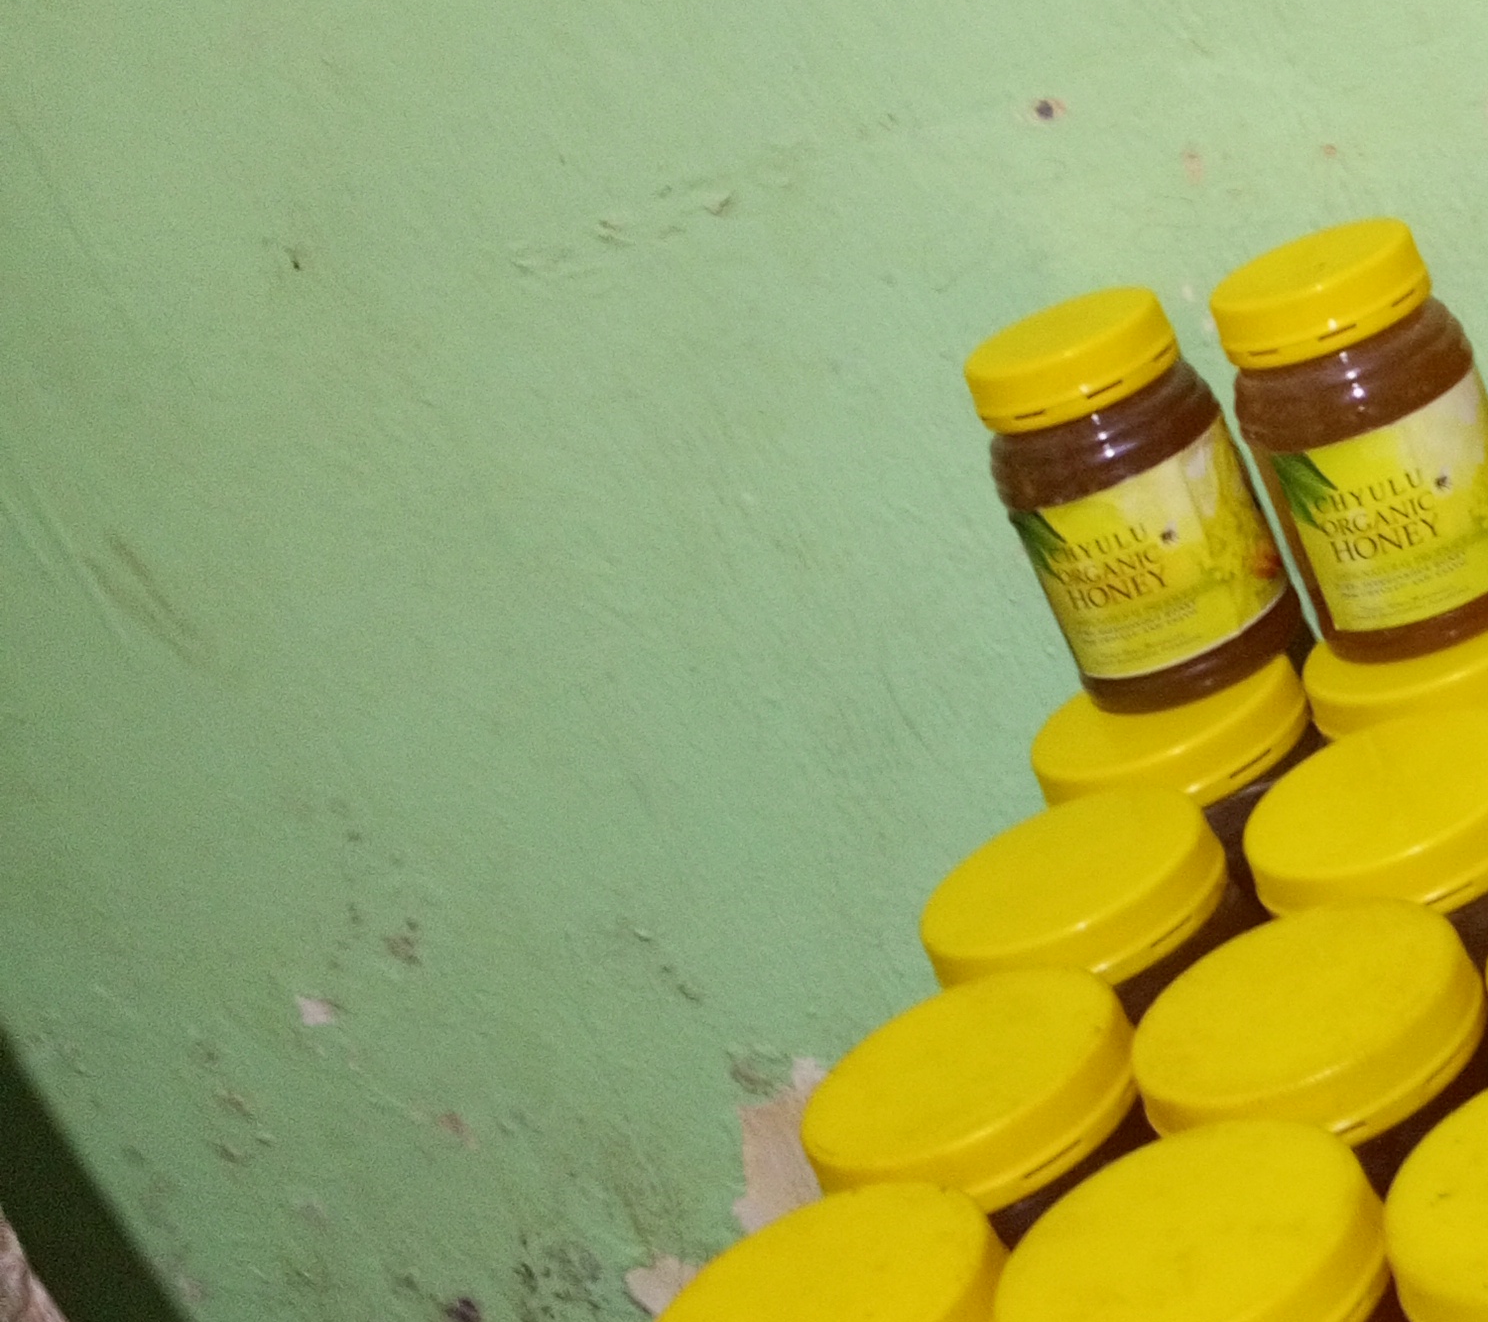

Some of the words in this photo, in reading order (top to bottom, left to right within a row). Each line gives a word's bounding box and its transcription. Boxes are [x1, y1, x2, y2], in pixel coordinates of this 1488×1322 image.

[1313, 468, 1424, 515] CHYULU
[1315, 491, 1436, 538] ORGANIC
[1330, 512, 1440, 564] HONEY
[1066, 567, 1168, 612] HONEY
